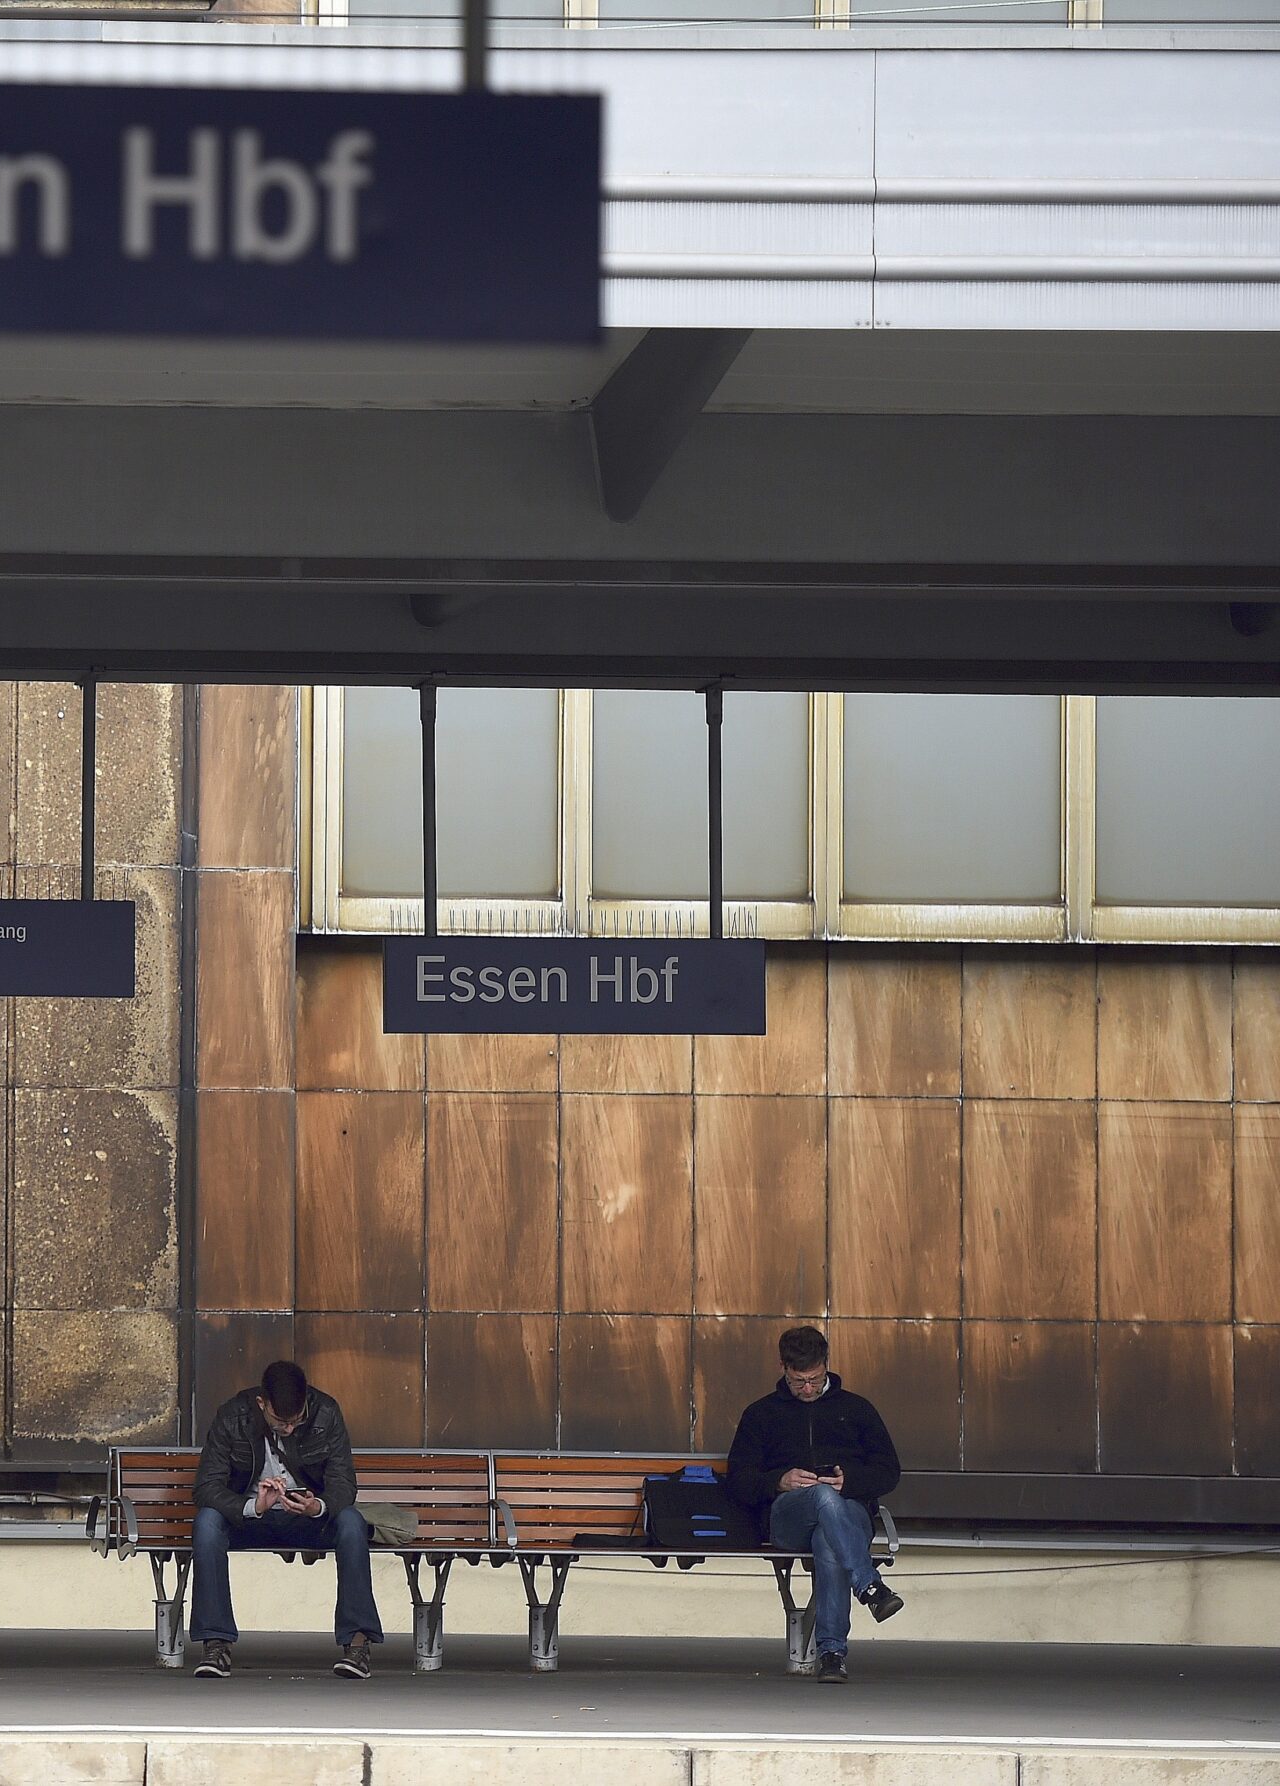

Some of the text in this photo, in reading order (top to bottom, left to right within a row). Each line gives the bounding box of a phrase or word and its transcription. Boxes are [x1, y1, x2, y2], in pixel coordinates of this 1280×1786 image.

[123, 128, 371, 262] Hbf
[416, 955, 679, 1003] Essen Hbf
